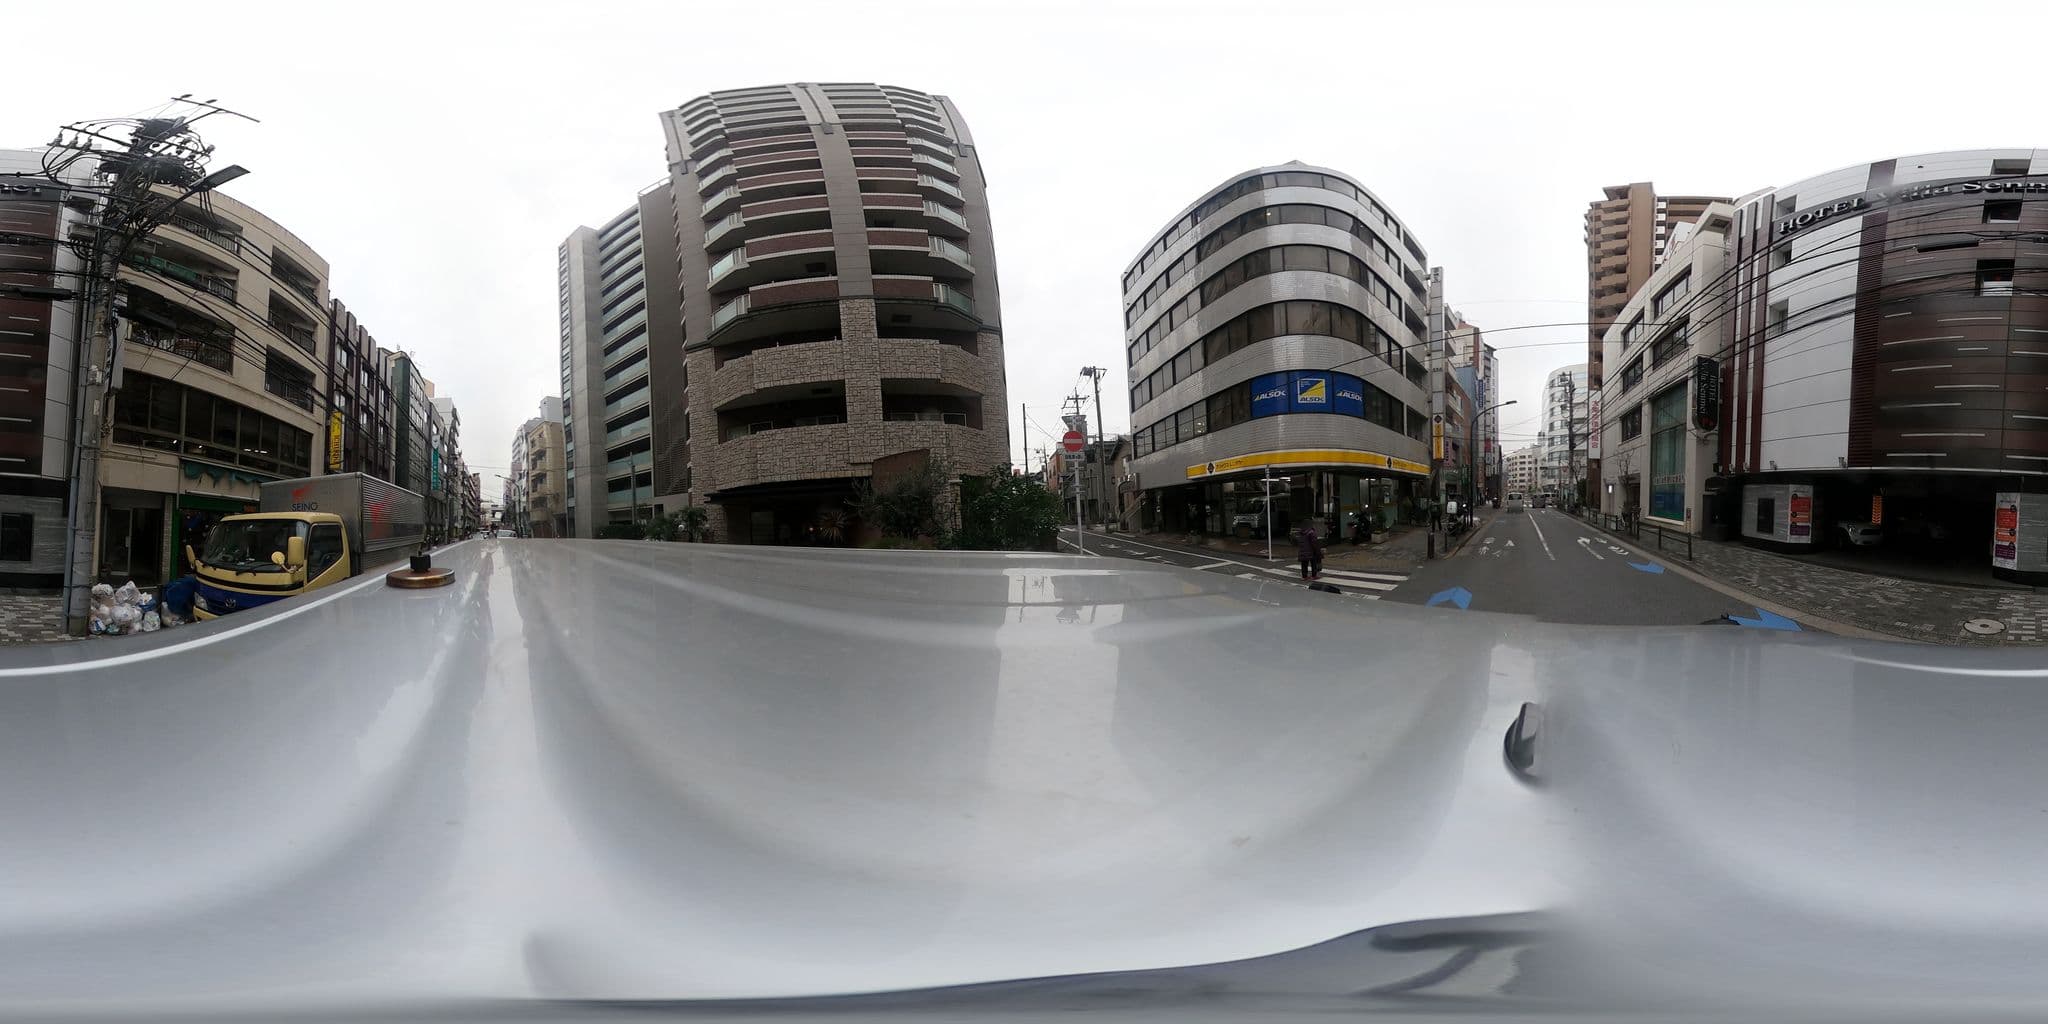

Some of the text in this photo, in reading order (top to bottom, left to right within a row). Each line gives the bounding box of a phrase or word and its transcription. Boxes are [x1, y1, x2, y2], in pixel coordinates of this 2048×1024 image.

[1779, 197, 1865, 234] HOTEL
[1260, 390, 1287, 400] ALSOK
[1343, 390, 1363, 401] ALSOK
[291, 502, 318, 512] SEINO
